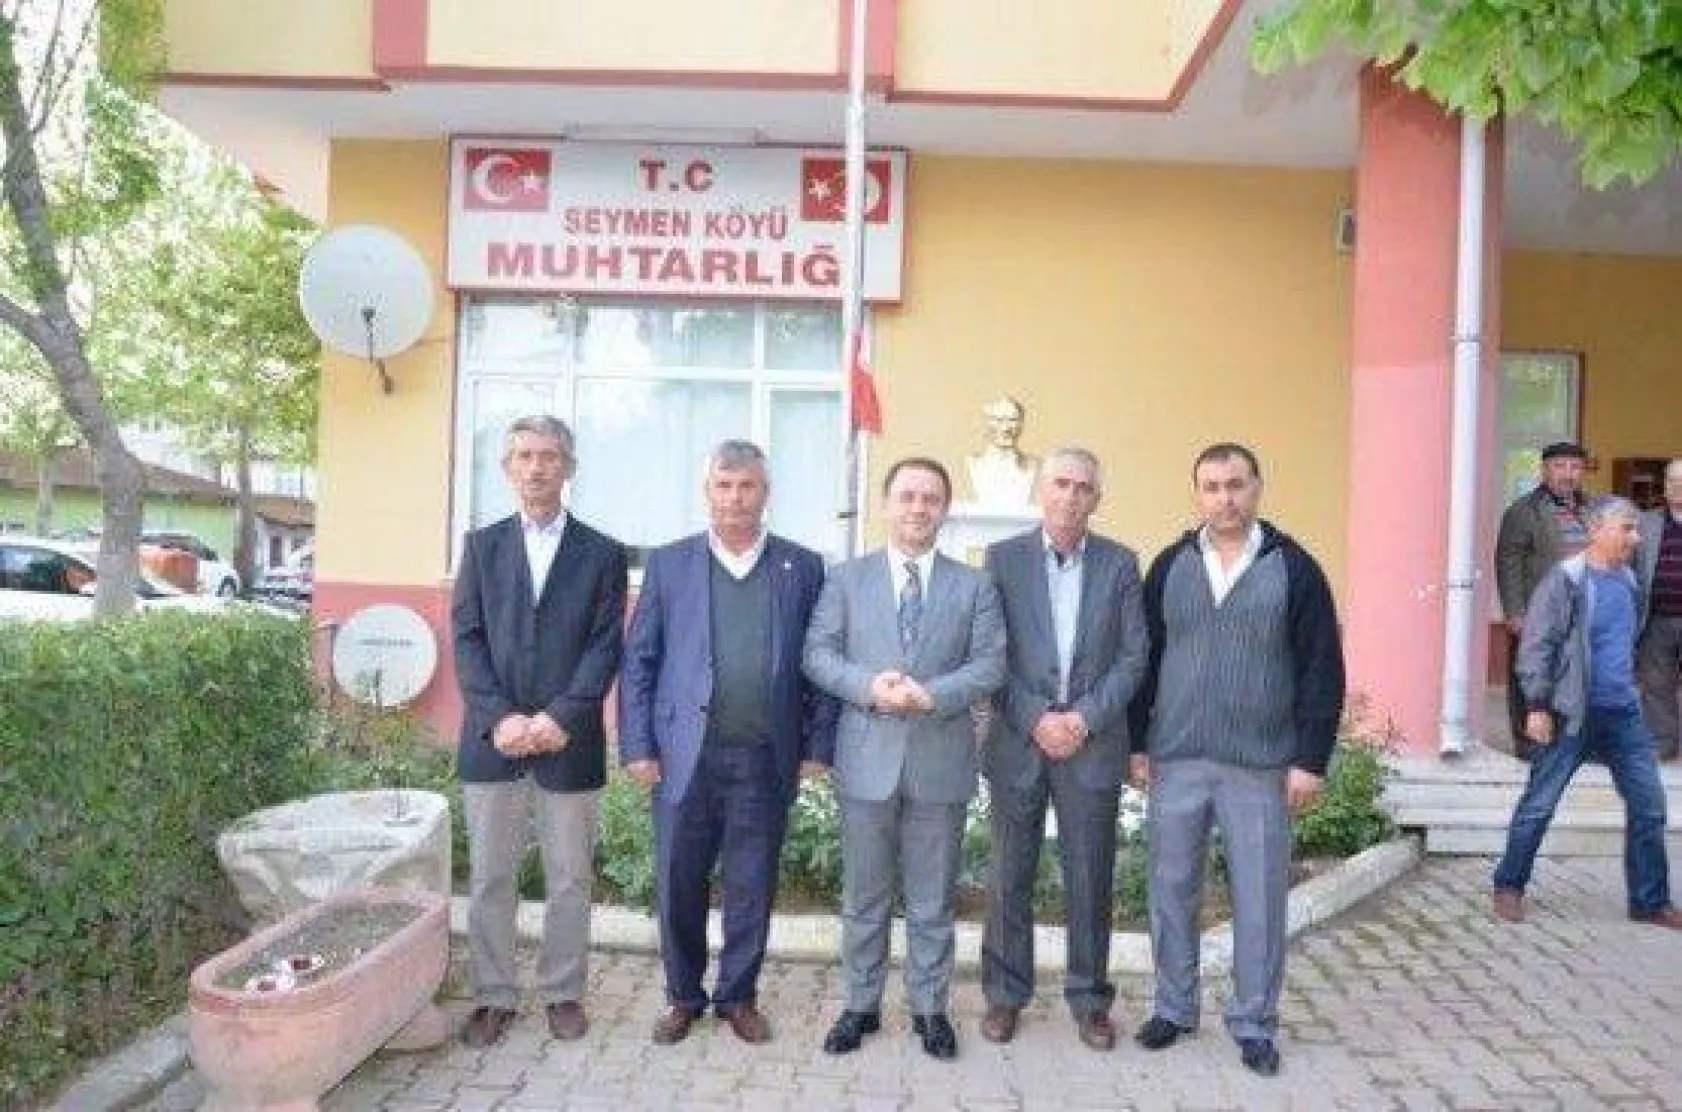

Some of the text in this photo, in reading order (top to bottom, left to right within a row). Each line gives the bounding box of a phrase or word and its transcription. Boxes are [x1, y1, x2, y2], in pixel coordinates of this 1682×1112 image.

[639, 159, 713, 192] T.C
[563, 207, 788, 240] SEYMEN KÖYÜ
[487, 244, 841, 286] MUHTARLIĞ
